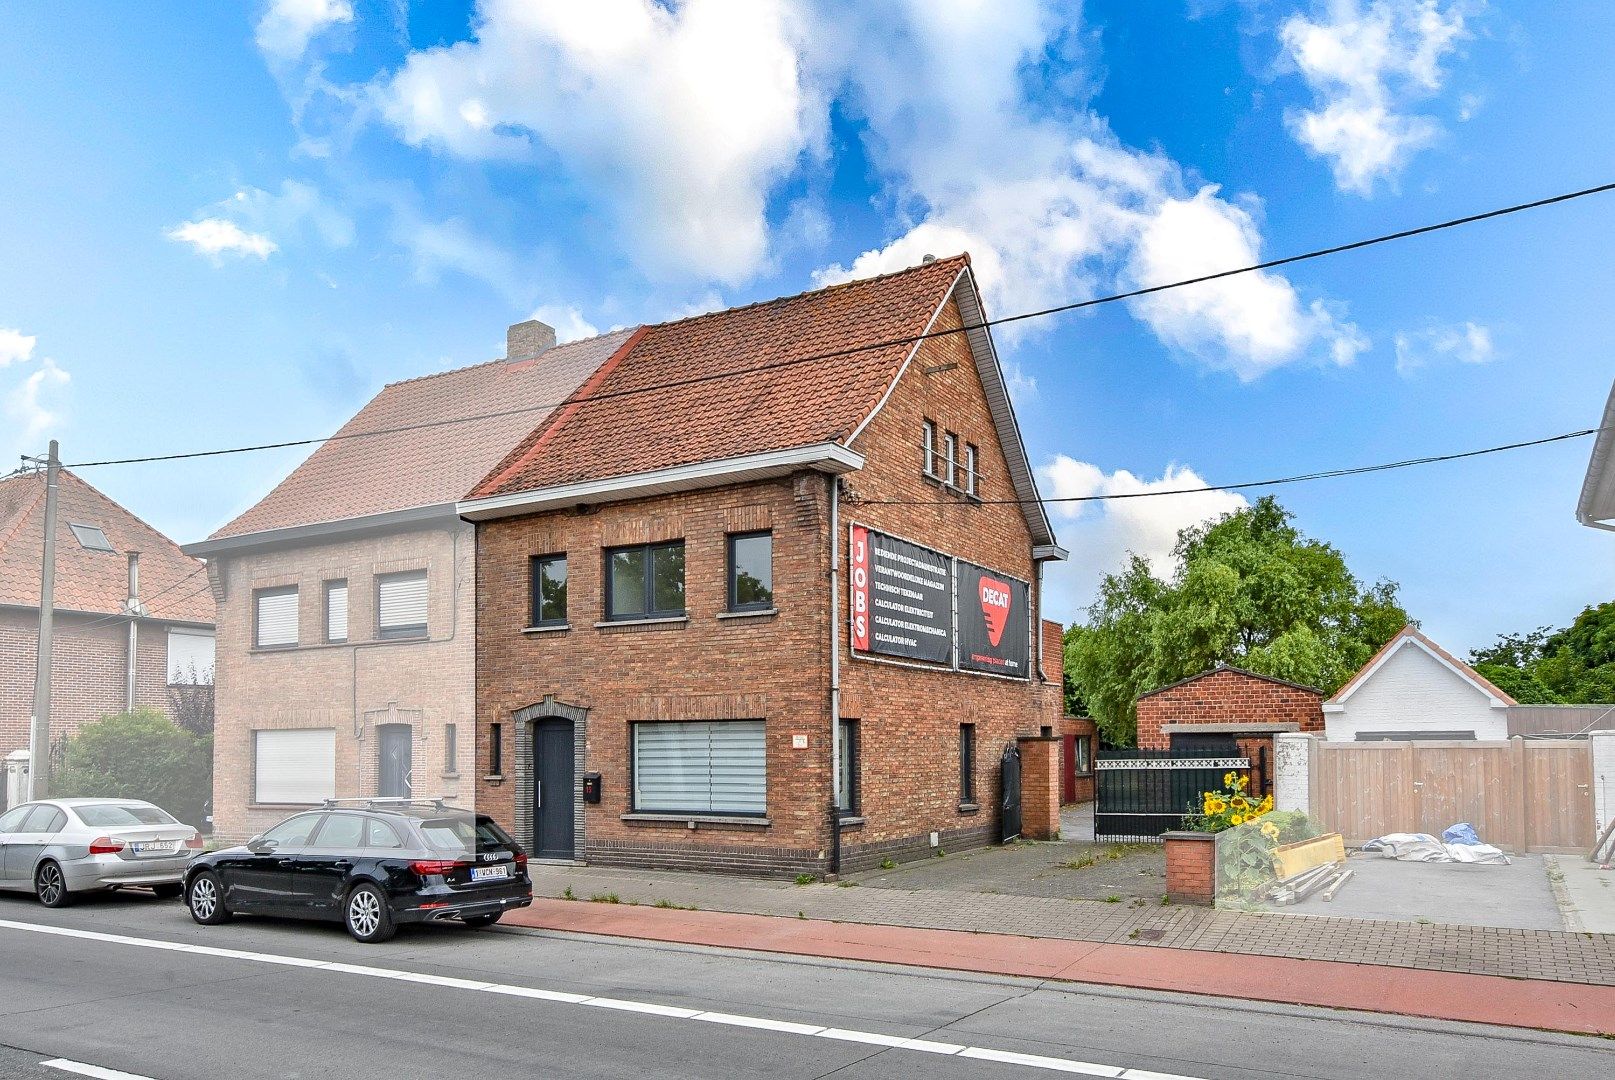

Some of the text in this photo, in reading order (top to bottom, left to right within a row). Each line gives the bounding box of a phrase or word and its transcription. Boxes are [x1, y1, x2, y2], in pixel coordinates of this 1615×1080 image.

[854, 541, 867, 638] JOBS
[875, 581, 923, 601] TECHNISCH TEKENAAR
[982, 587, 1008, 608] DECAT
[875, 598, 904, 612] CALCULATOR
[875, 616, 904, 629] CALCULATOR
[875, 633, 918, 647] CALCULATOR HVAC
